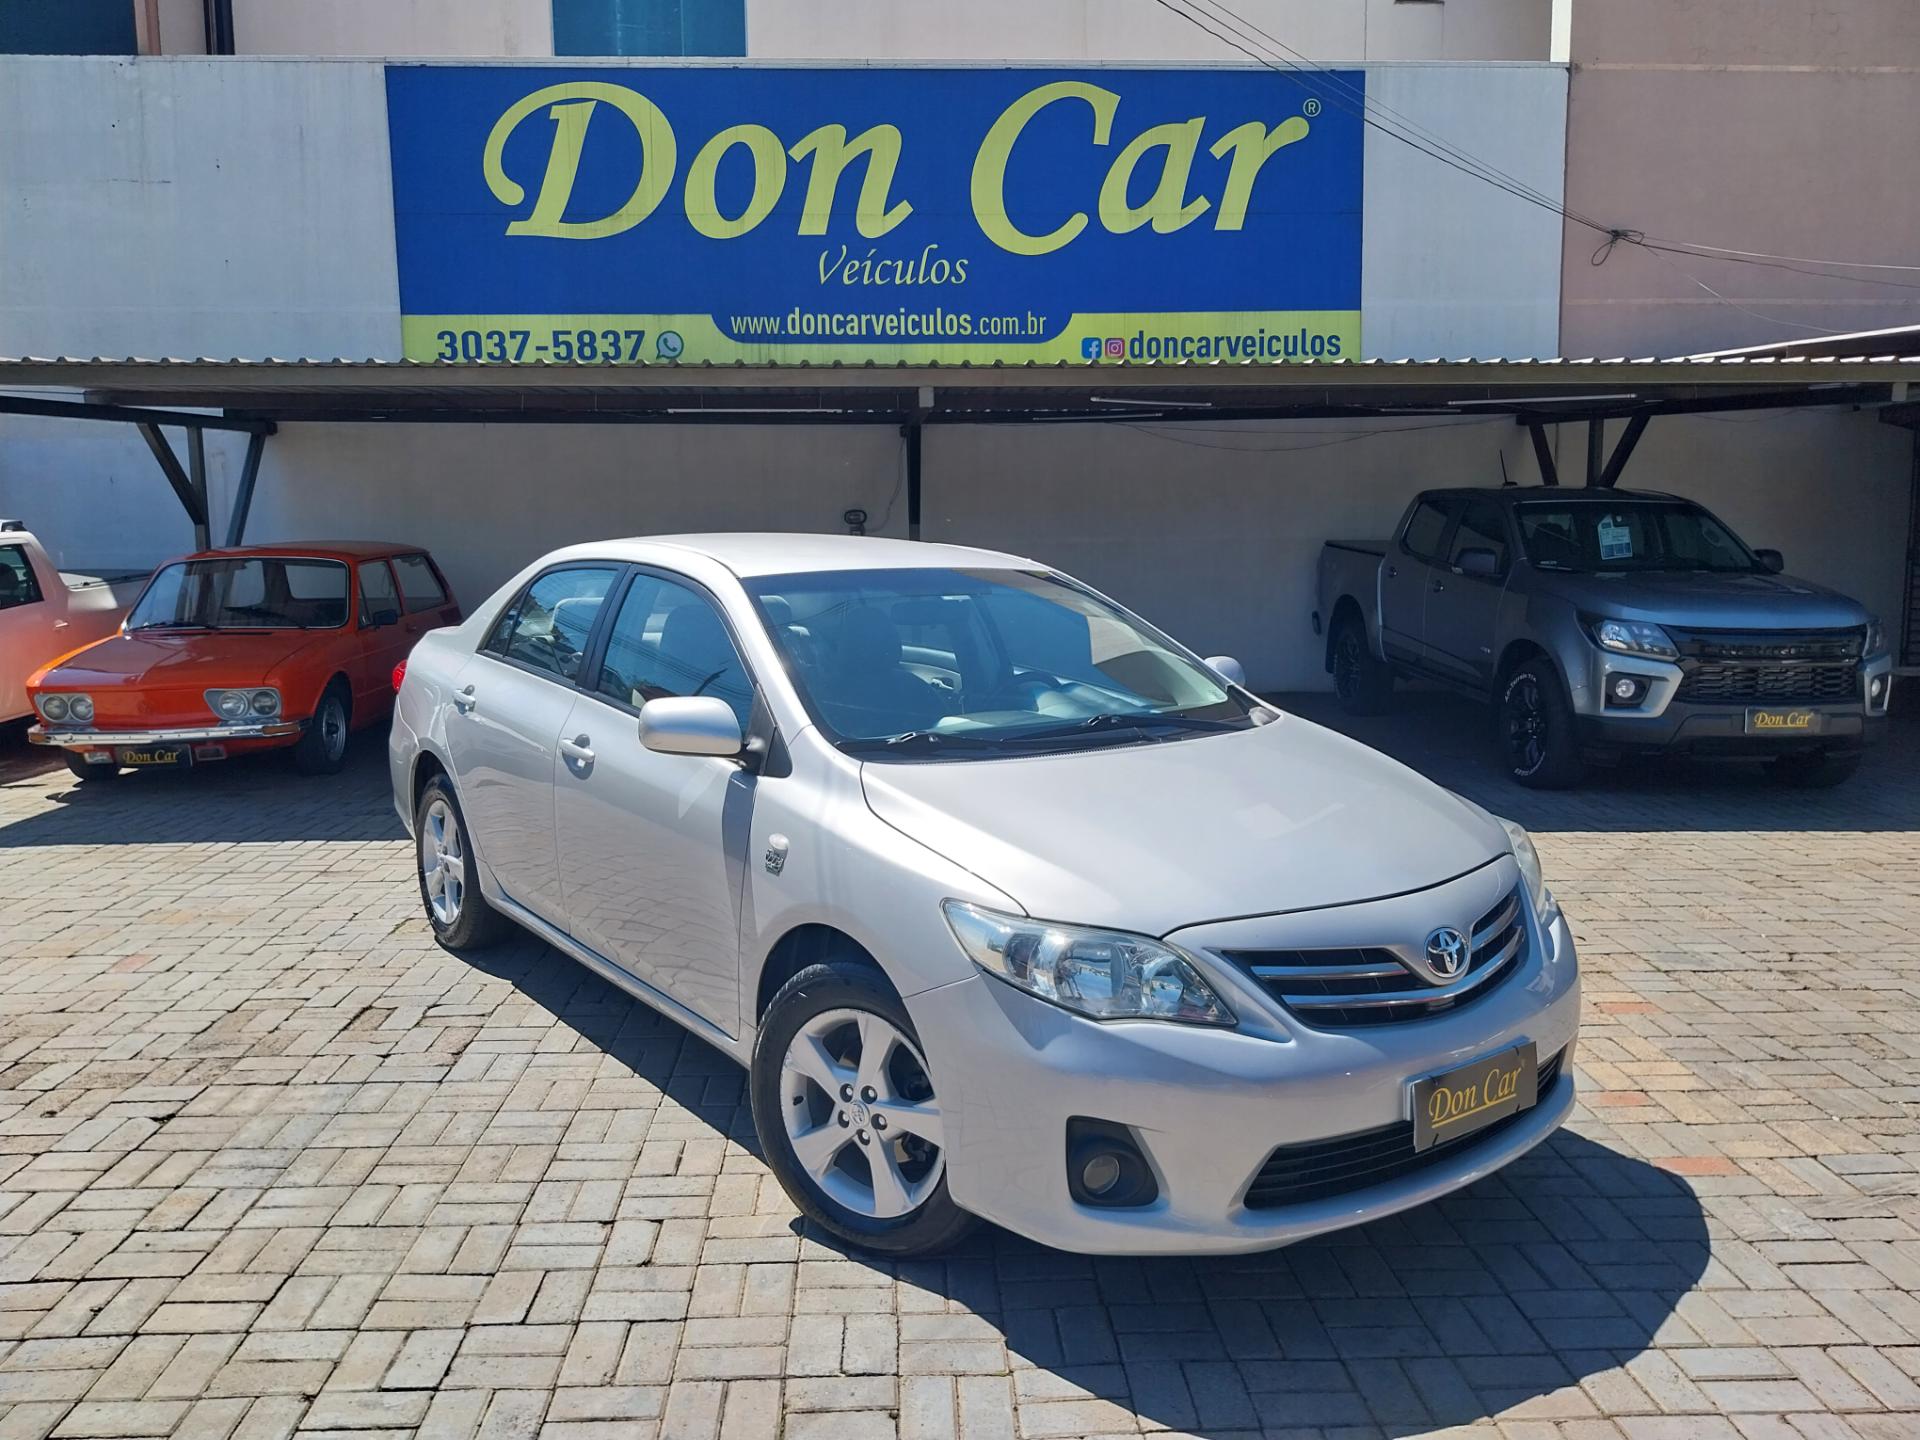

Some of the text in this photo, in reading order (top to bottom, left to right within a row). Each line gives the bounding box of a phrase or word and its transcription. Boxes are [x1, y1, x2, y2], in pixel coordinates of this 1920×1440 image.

[483, 81, 914, 240] Don
[970, 80, 1310, 256] Car
[818, 244, 969, 286] Veículos
[730, 307, 1047, 336] www.doncarveiculos.com.br
[436, 330, 646, 362] 3037-5837
[1129, 328, 1341, 359] doncarveiculos
[1754, 711, 1812, 727] Don Car
[123, 749, 179, 763] Don Car
[1428, 1067, 1522, 1122] Don Car
